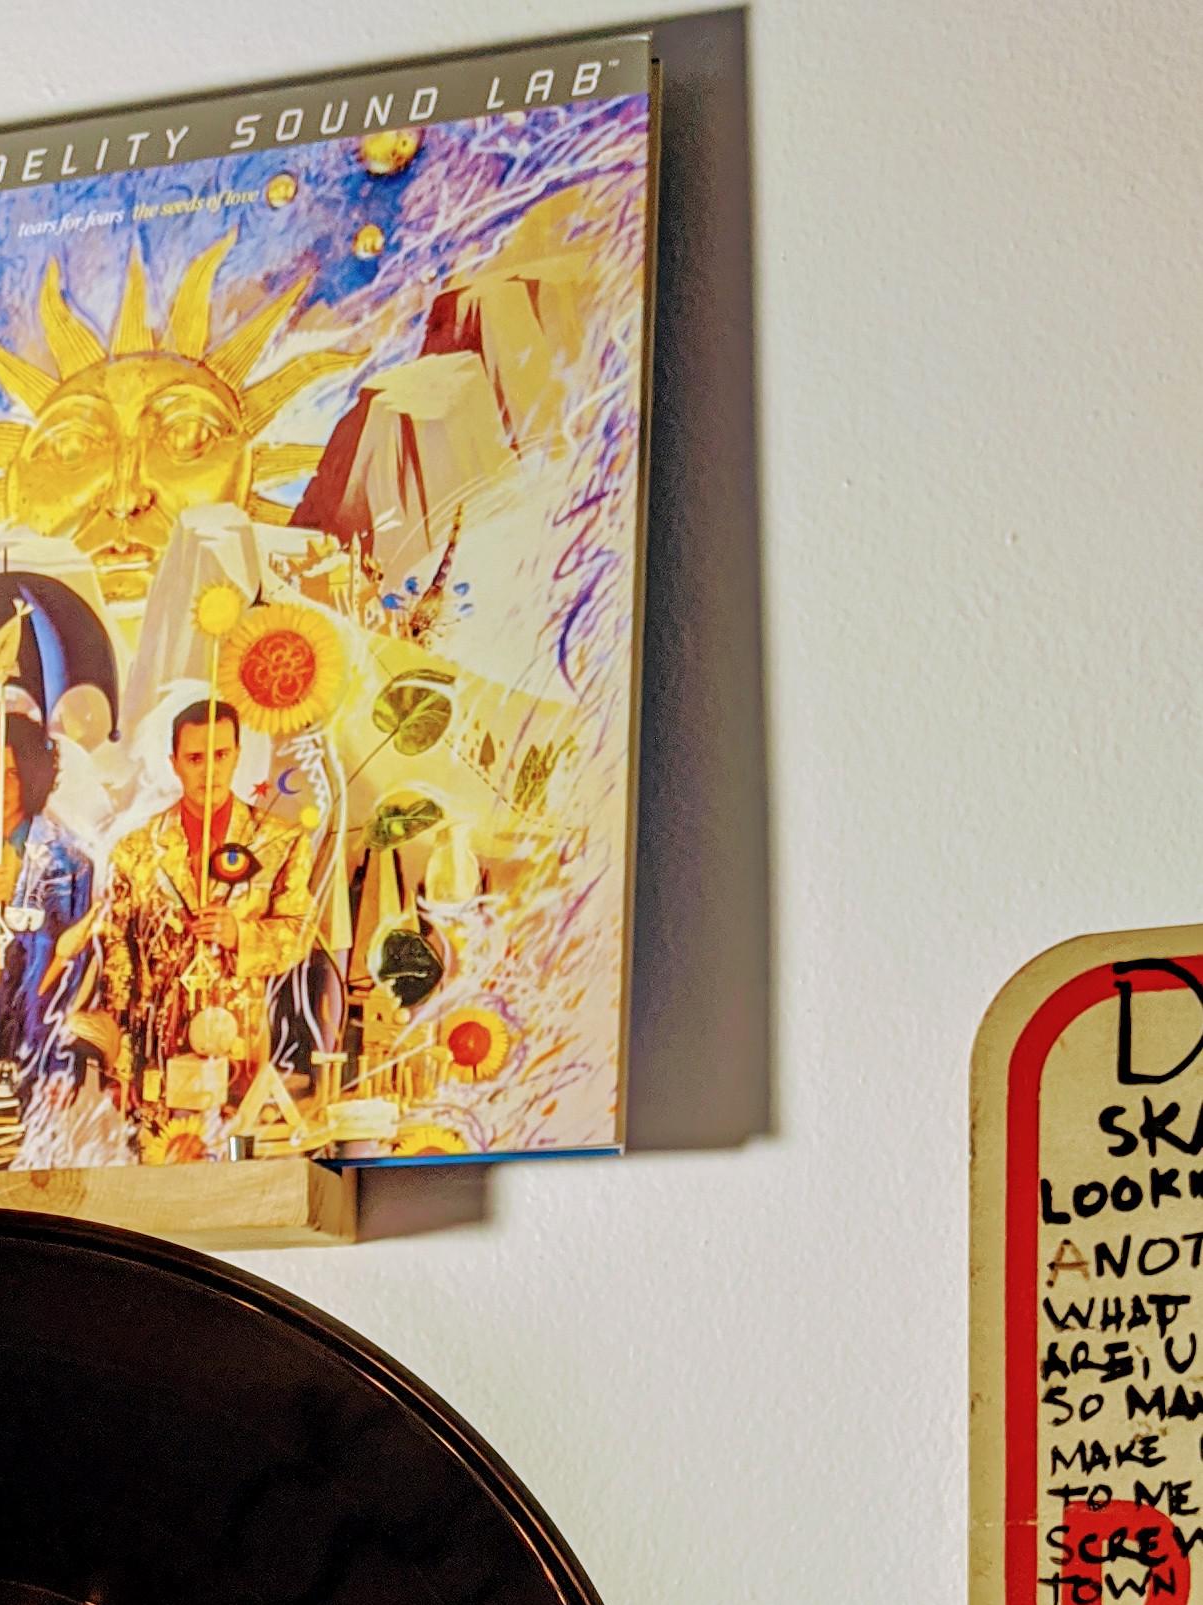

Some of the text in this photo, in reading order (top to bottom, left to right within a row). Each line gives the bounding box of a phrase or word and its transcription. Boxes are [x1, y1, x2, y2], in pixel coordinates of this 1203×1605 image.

[229, 85, 438, 150] SOUND
[17, 221, 58, 238] tears
[56, 212, 82, 235] for
[80, 208, 125, 233] fears
[132, 202, 157, 221] the
[159, 194, 204, 217] seeds
[224, 188, 260, 207] love
[1041, 1385, 1104, 1427] SO
[1050, 1435, 1167, 1477] MAKE
[1047, 1483, 1113, 1512] TO
